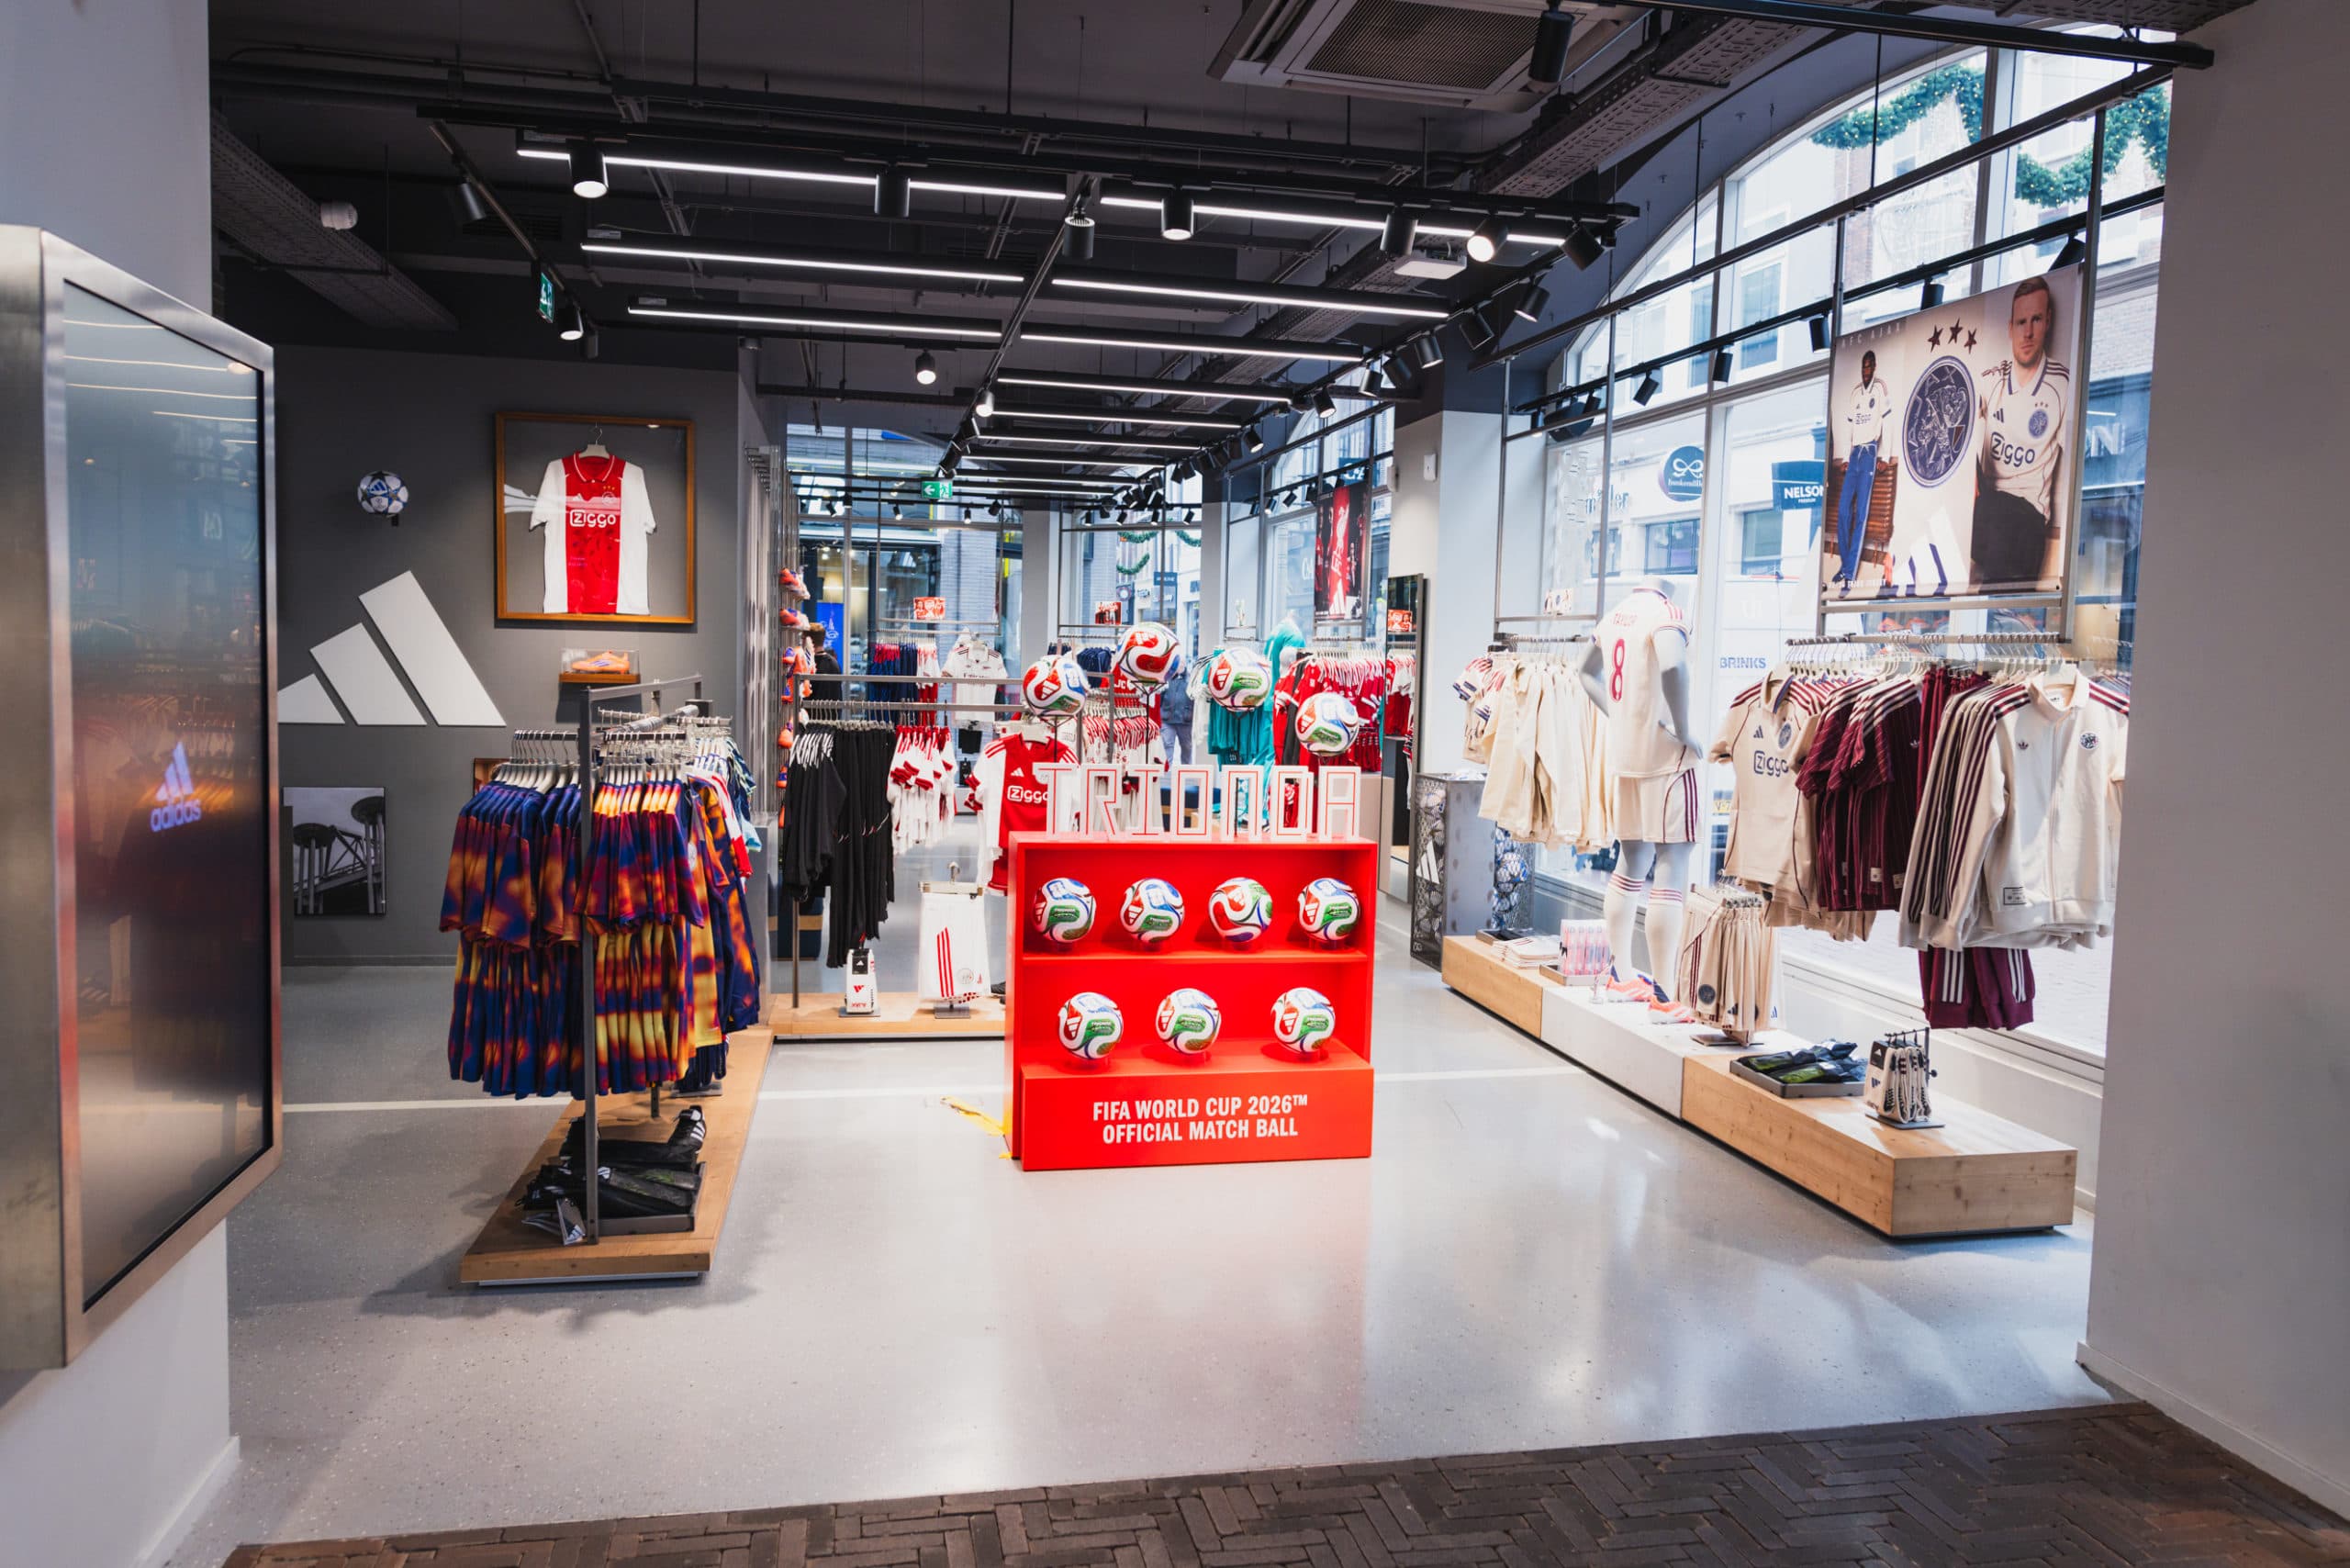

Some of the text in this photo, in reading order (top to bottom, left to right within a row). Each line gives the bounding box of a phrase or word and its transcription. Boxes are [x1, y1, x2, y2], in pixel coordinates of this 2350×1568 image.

[1610, 638, 1626, 702] 8
[151, 800, 201, 833] adidas
[1033, 762, 1361, 841] TRIONDA
[1093, 1094, 1308, 1121] FIFA WORLD CUP 2026™
[1103, 1117, 1299, 1145] OFFICIAL MATCH BALL
